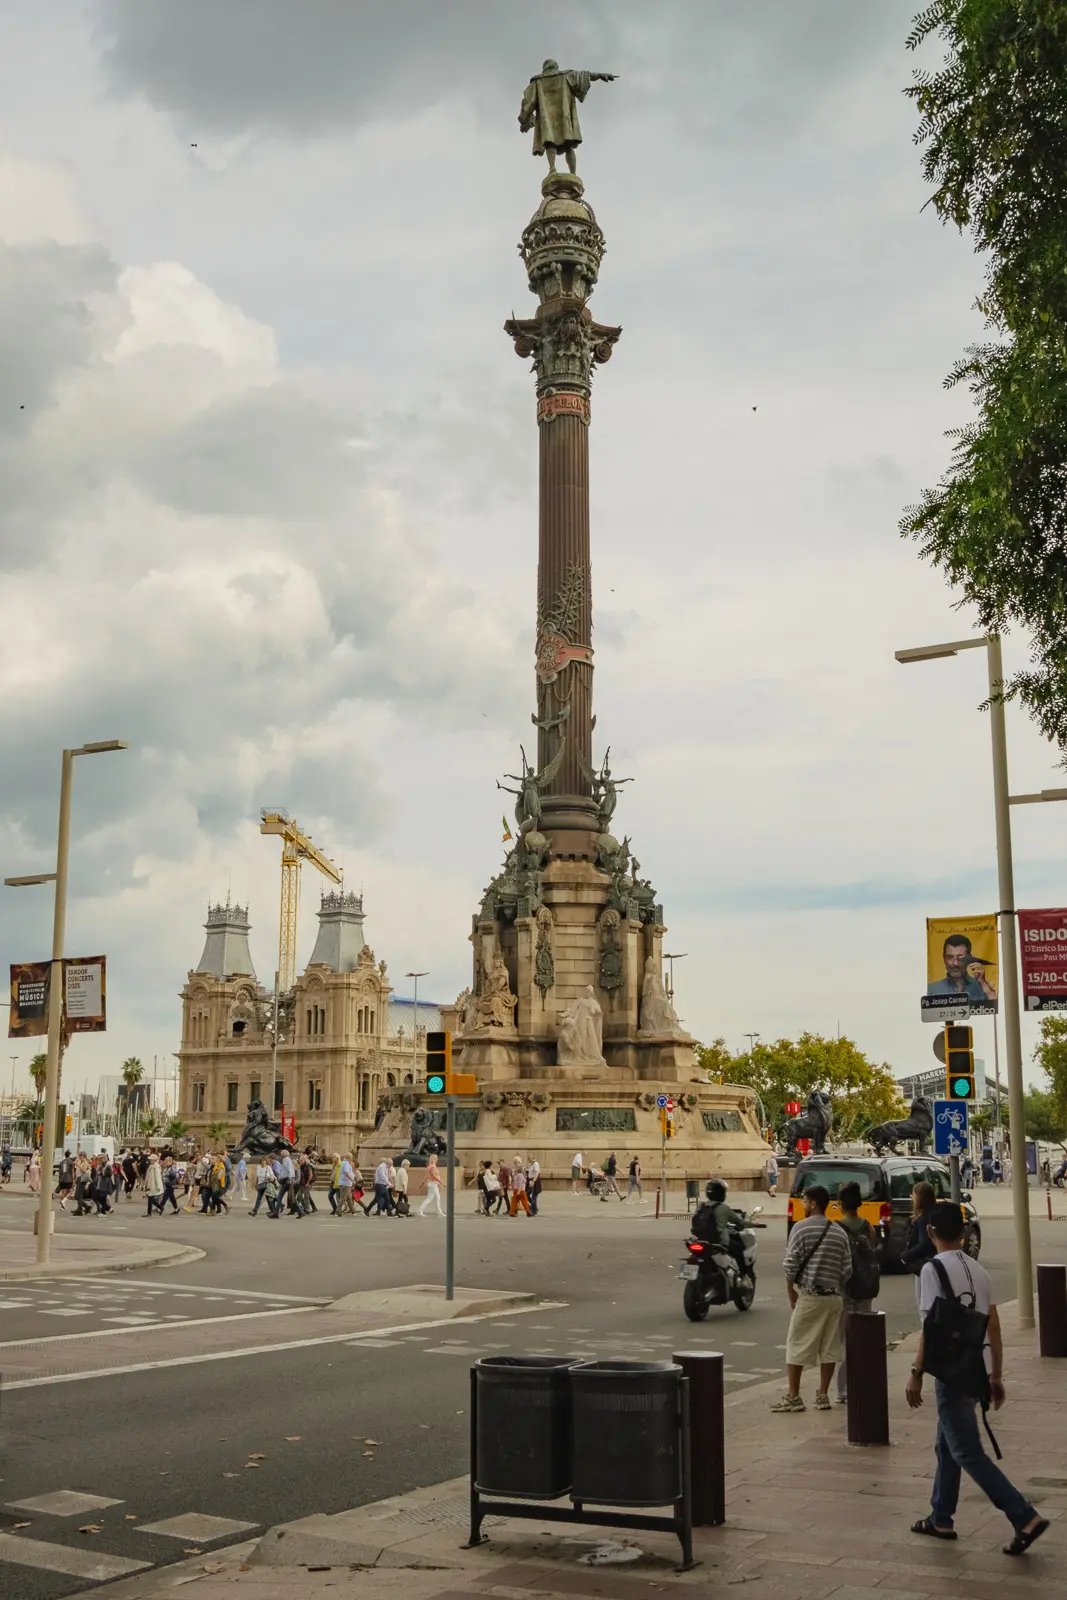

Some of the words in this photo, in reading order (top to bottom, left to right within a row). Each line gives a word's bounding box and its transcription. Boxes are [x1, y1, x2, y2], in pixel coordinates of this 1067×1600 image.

[1043, 953, 1058, 961] Pau
[20, 993, 44, 1001] MÚSICA
[931, 998, 948, 1006] Josep
[948, 996, 968, 1004] Carner
[969, 1005, 996, 1015] ódico
